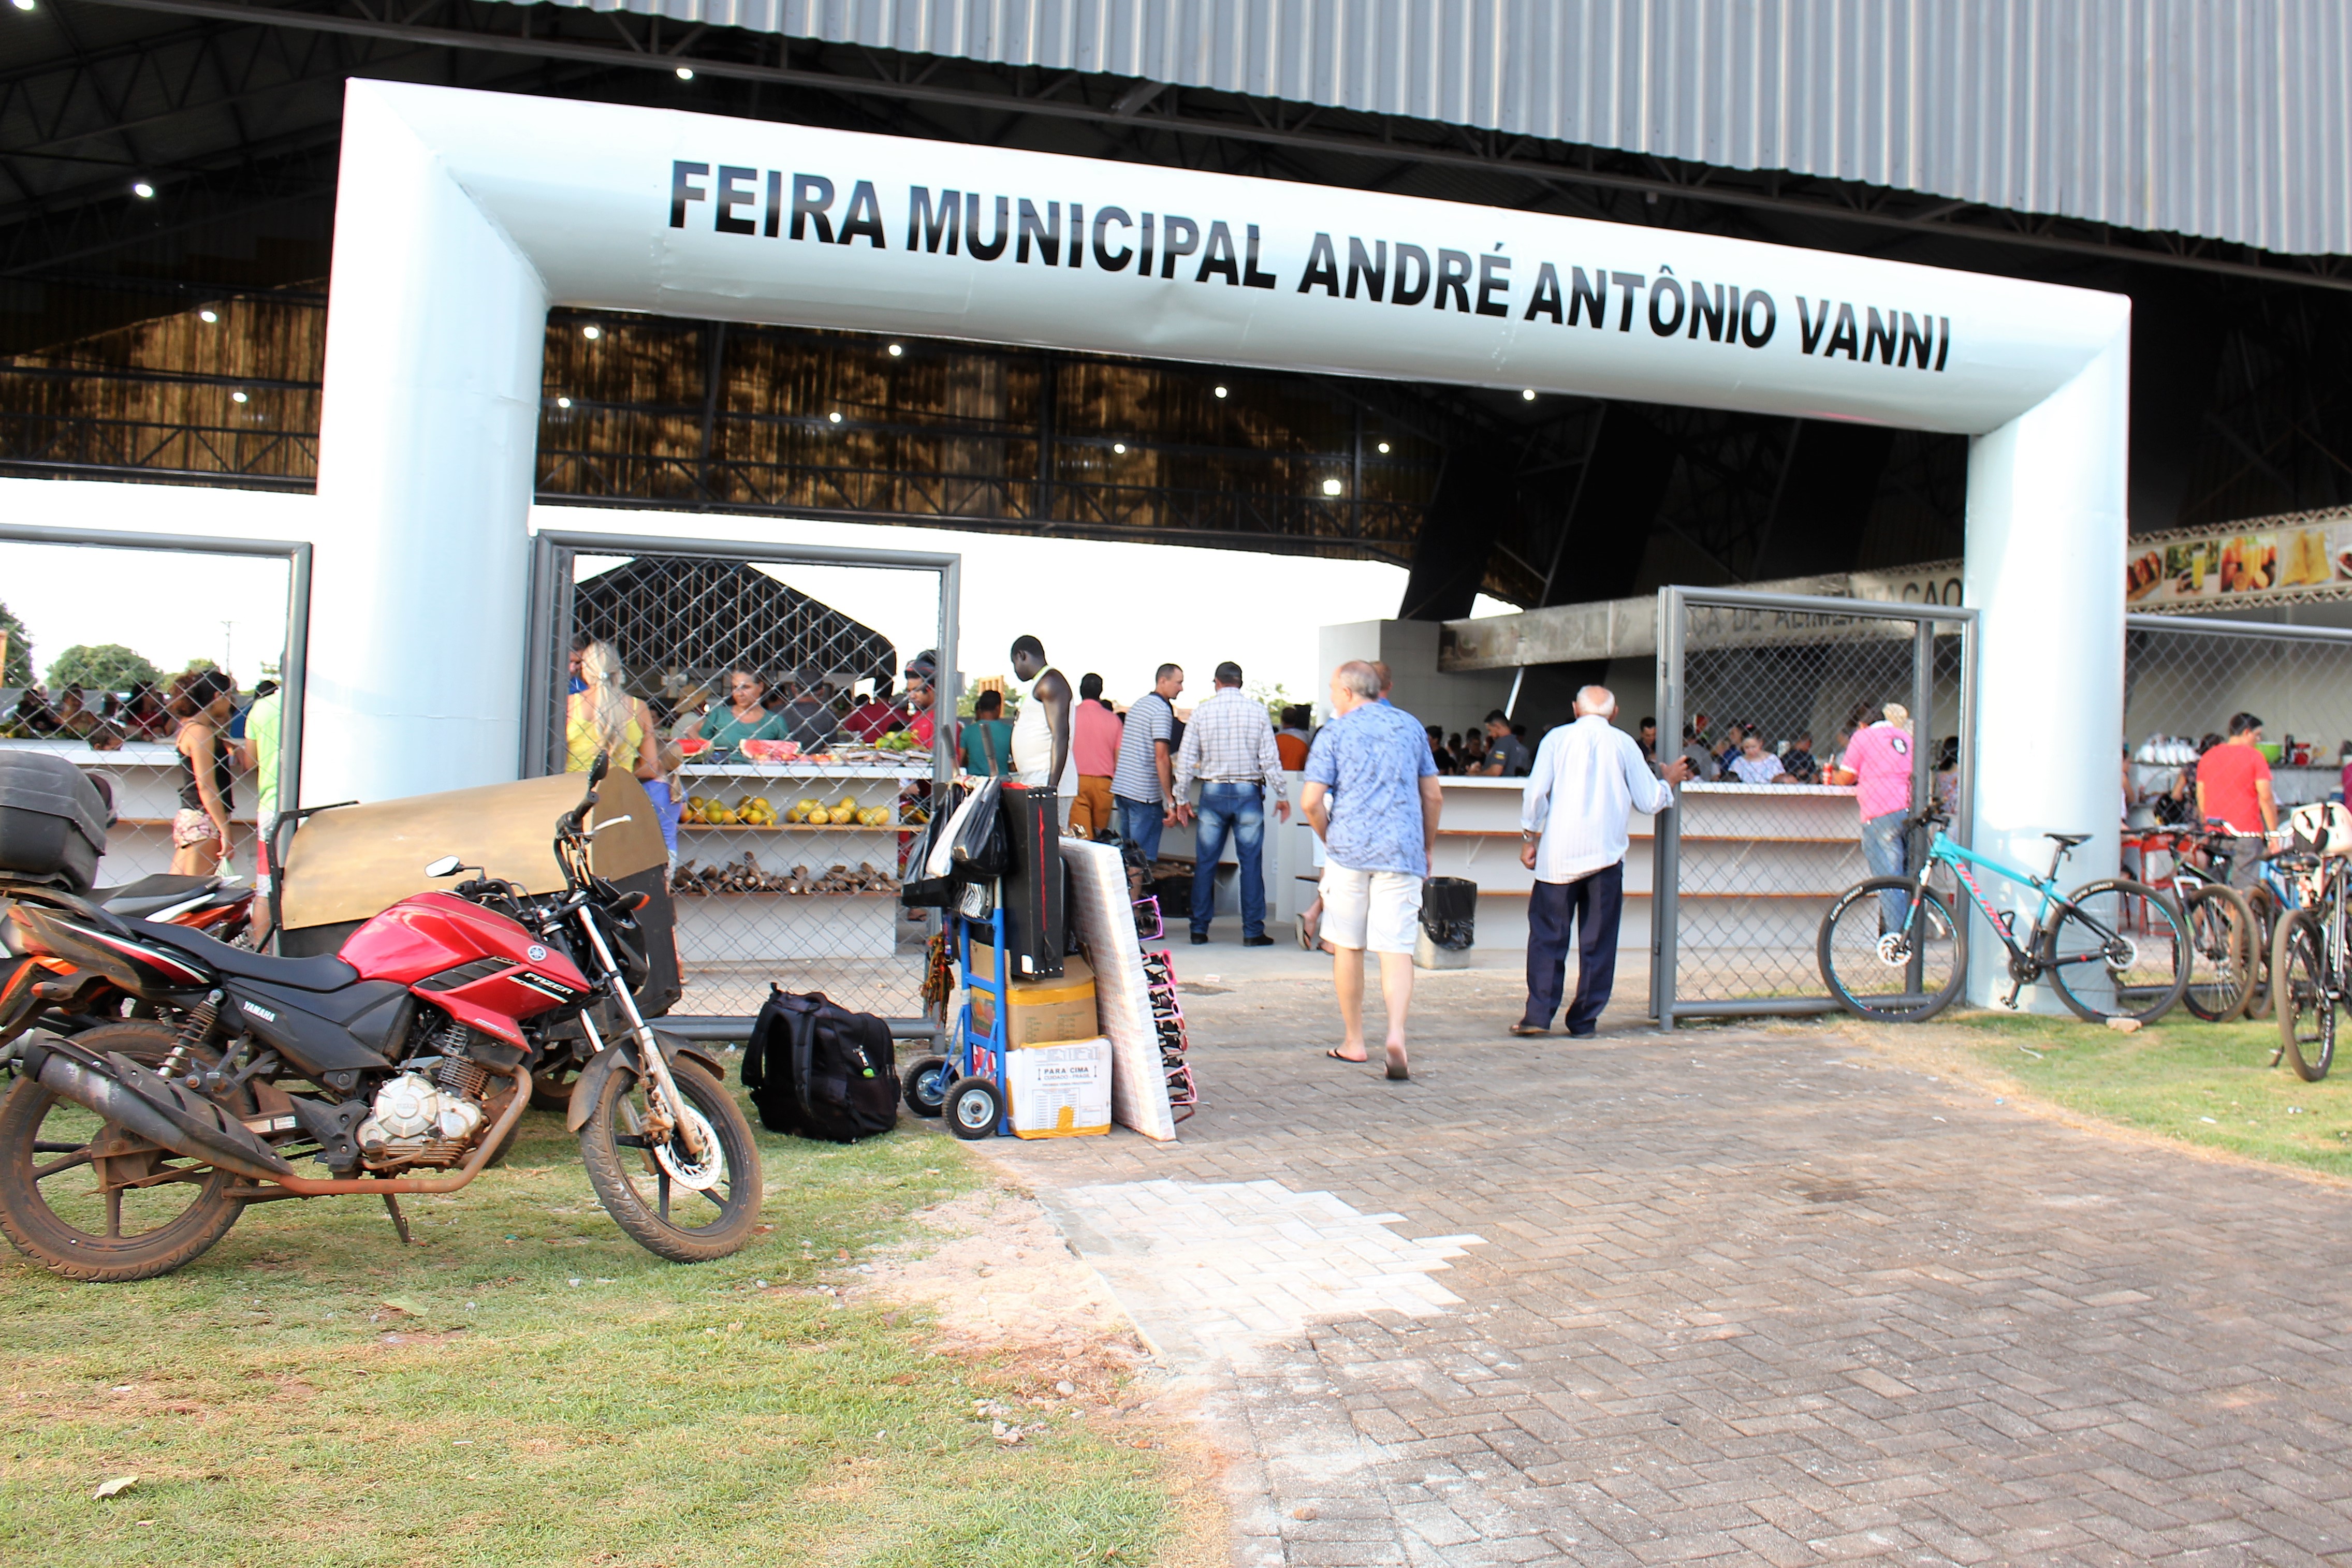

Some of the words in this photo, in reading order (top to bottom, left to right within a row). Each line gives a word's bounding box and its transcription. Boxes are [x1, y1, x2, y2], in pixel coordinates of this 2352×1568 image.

[669, 160, 886, 249] FEIRA
[906, 185, 1277, 290] MUNICIPAL
[1296, 232, 1511, 318] ANDRÉ
[1523, 262, 1776, 349] ANTÔNIO
[1796, 297, 1949, 372] VANNI
[524, 972, 574, 994] FAZER
[243, 1001, 275, 1022] YAMAHA
